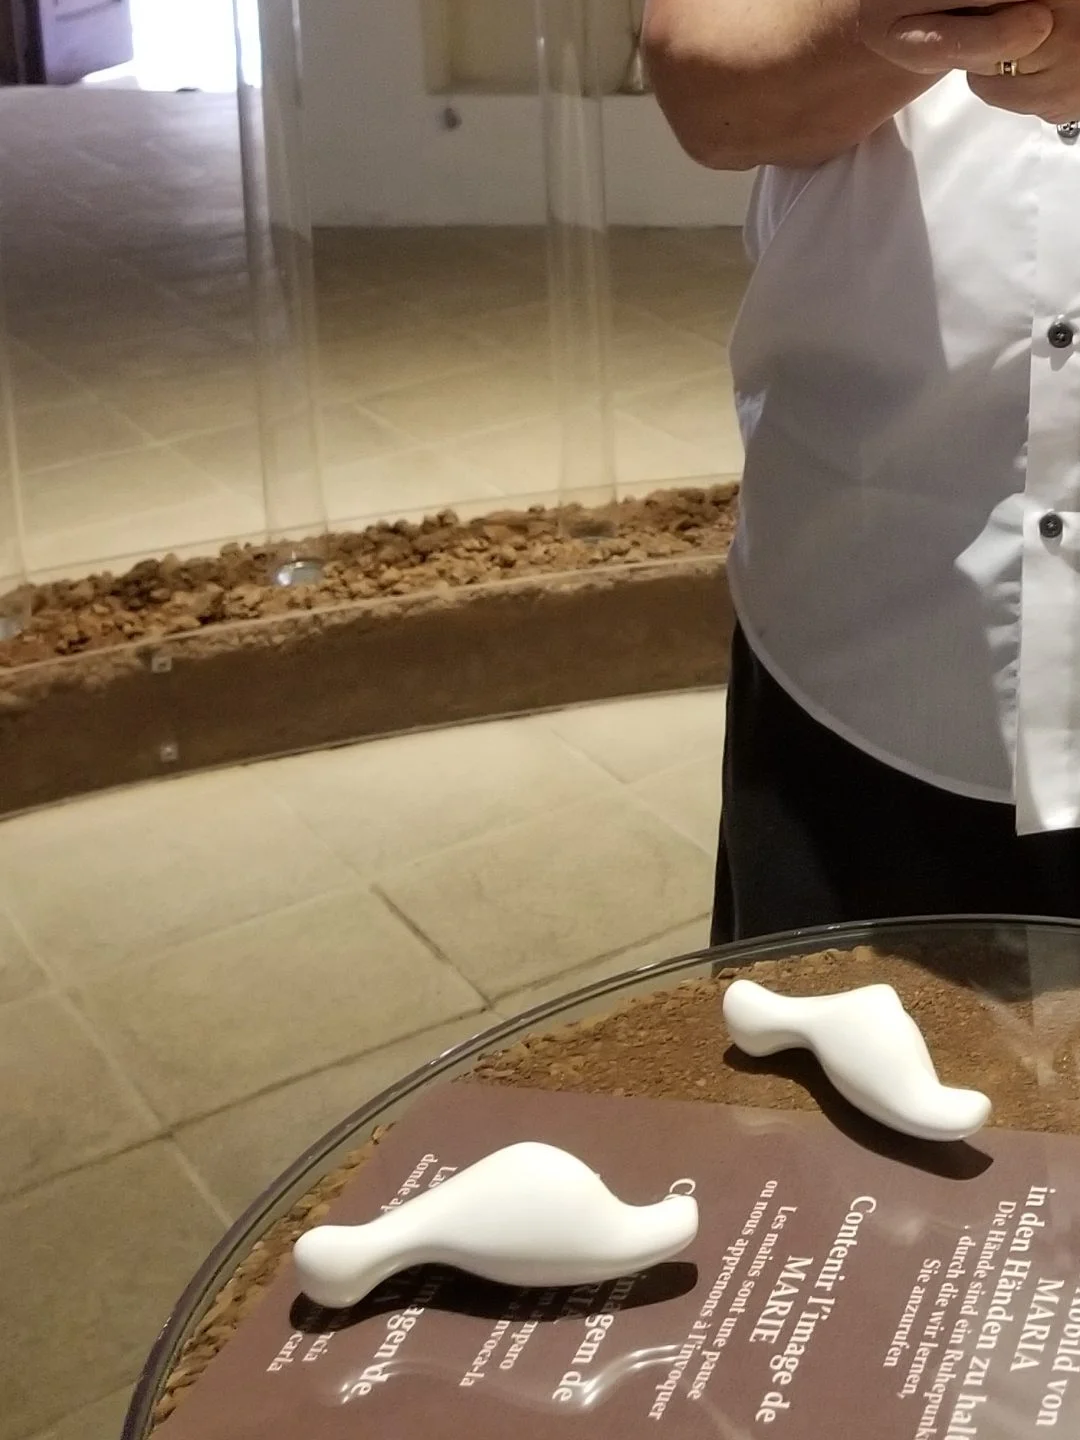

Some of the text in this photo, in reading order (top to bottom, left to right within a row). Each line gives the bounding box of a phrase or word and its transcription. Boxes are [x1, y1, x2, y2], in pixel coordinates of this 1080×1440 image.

[397, 1153, 439, 1195] donde
[1025, 1185, 1057, 1207] in
[993, 1201, 1017, 1227] Die
[1010, 1212, 1045, 1252] den
[973, 1230, 1007, 1279] Hände
[648, 1180, 778, 1421] ou nous apprenons à l'invoquer
[687, 1206, 798, 1401] Les mains sont une pause
[749, 1255, 813, 1343] MARIE
[755, 1195, 877, 1423] Contenir l'image de
[883, 1258, 942, 1368] Sie anzurufen
[896, 1235, 976, 1399] durch die wir lernen,
[960, 1281, 986, 1316] sind
[976, 1258, 1032, 1350] Händen
[949, 1319, 972, 1344] ein
[1010, 1277, 1065, 1372] MARIA
[552, 1371, 588, 1401] de
[963, 1355, 991, 1386] zu
[1035, 1379, 1068, 1427] von
